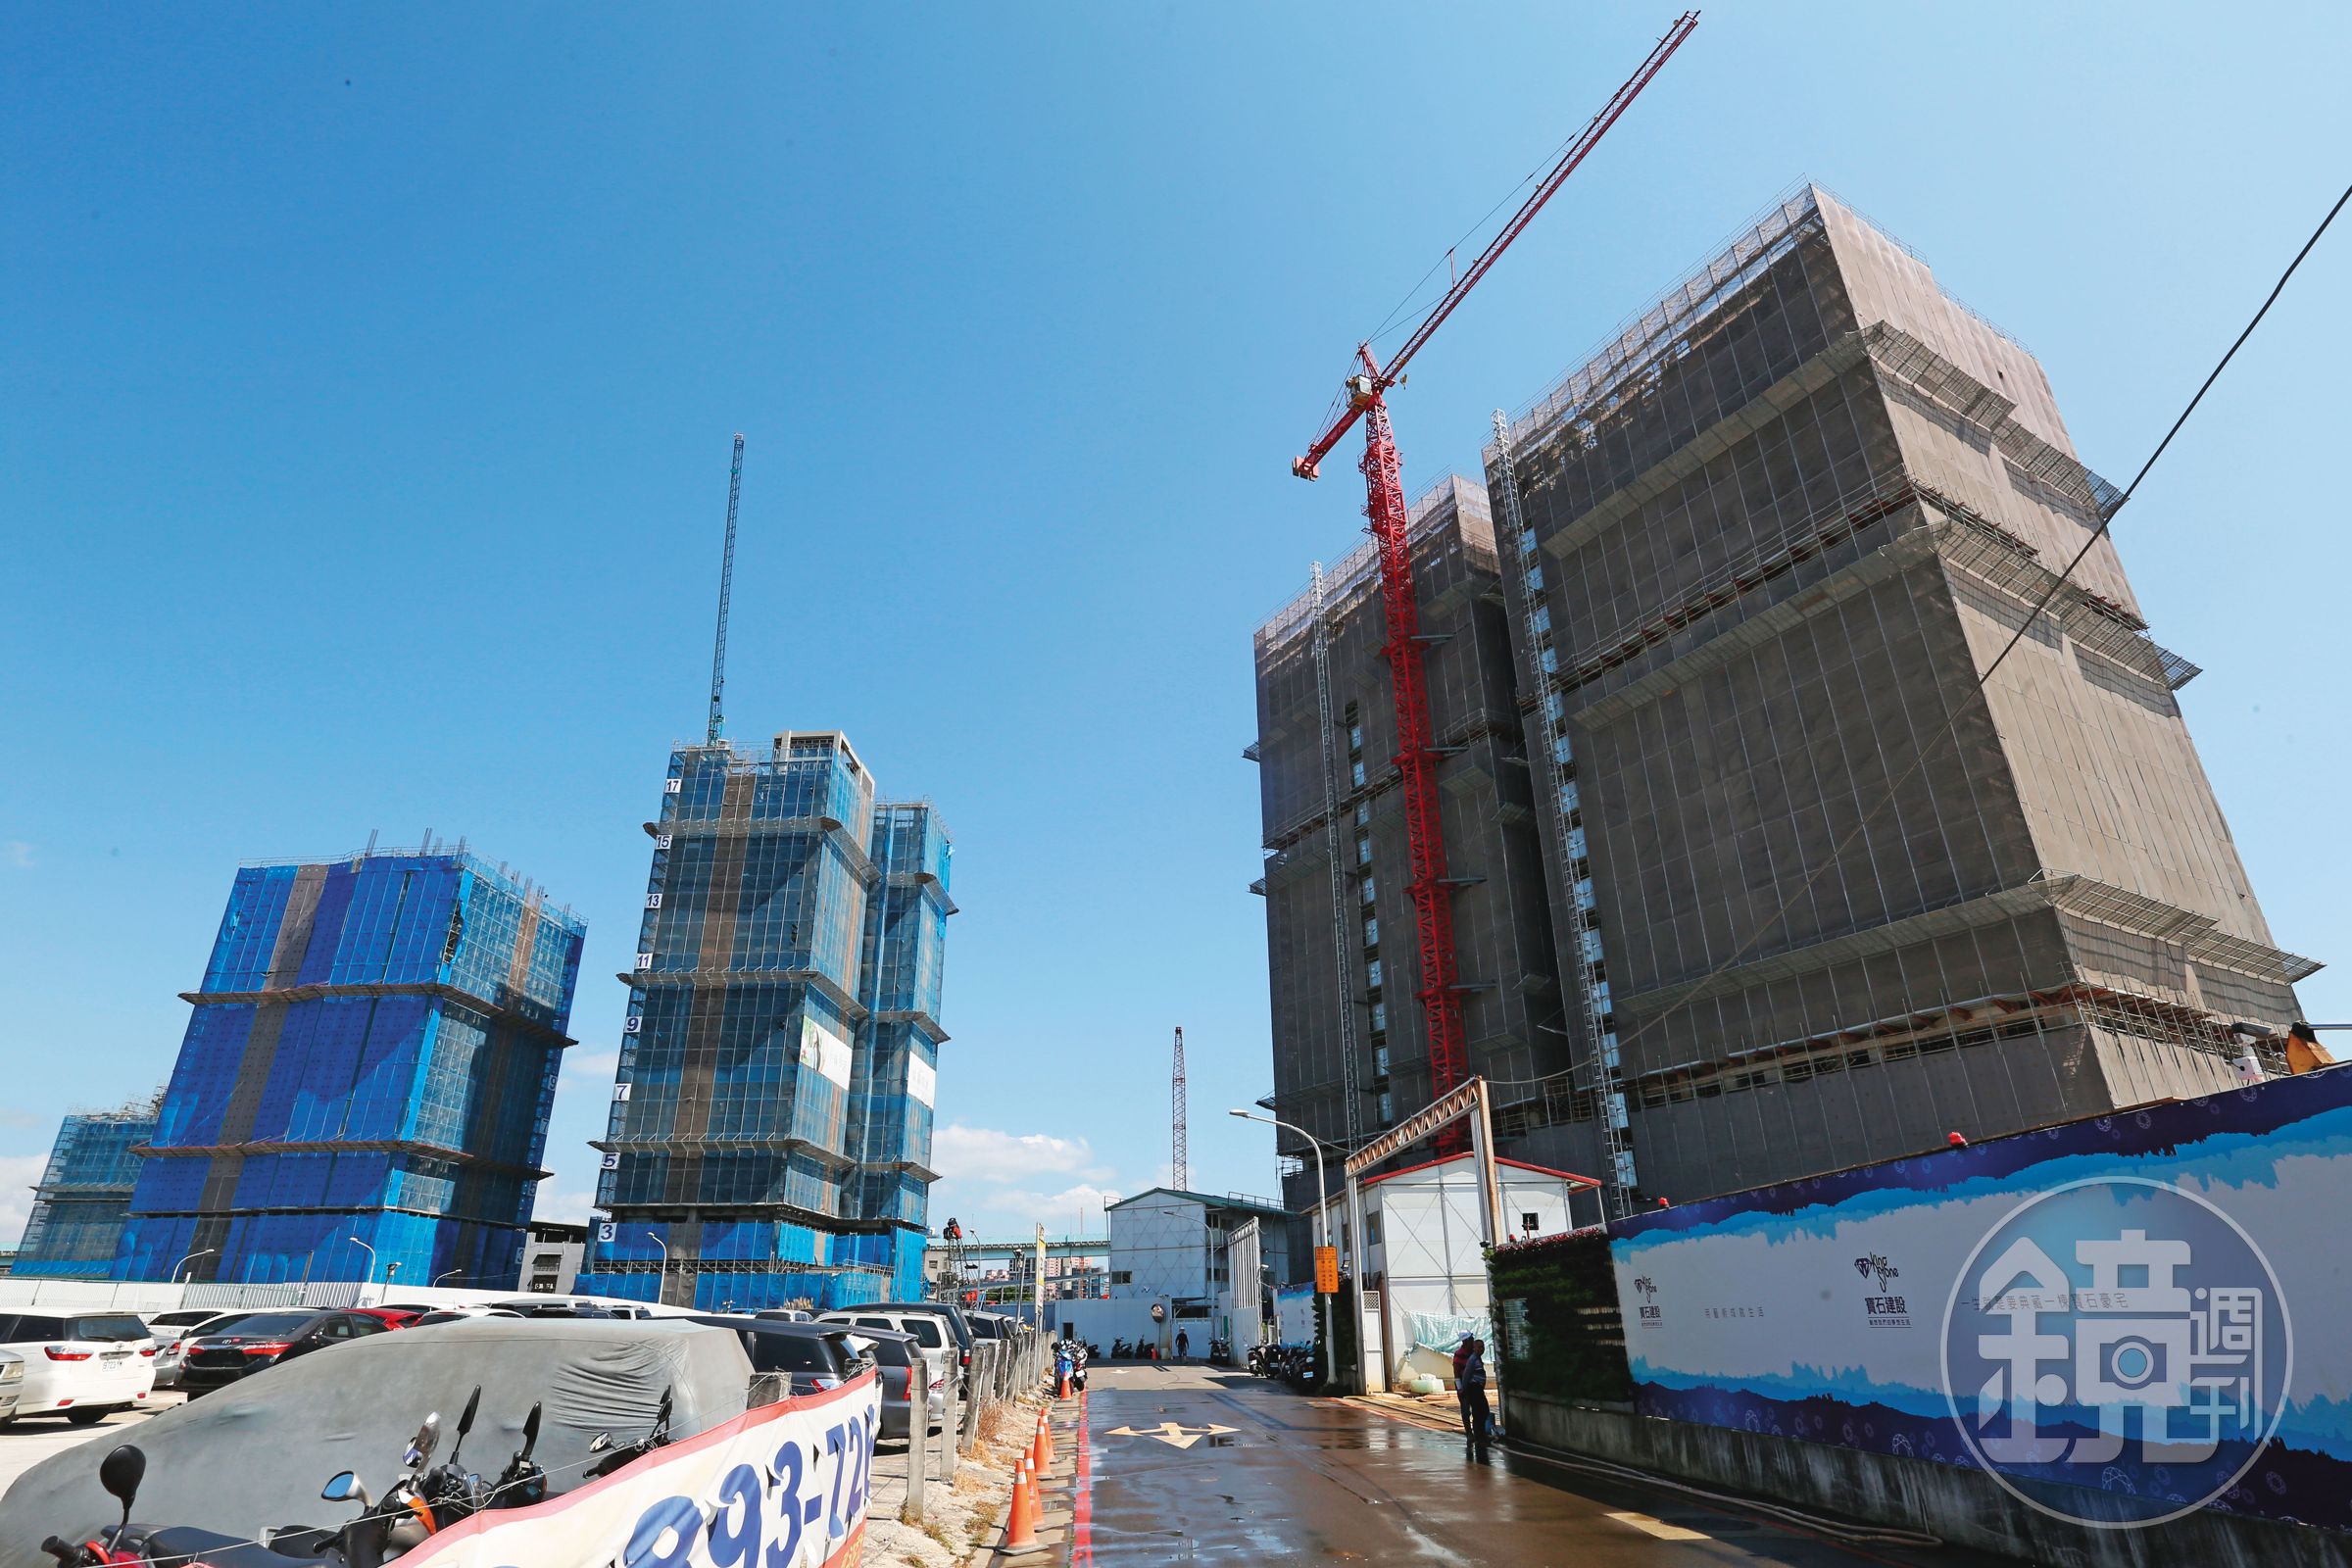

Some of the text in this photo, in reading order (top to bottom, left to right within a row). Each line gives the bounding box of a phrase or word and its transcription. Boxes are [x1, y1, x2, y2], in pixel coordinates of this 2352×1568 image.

[666, 780, 679, 792] 17
[658, 836, 670, 848] 15
[648, 896, 660, 906] 13
[638, 956, 650, 967] 11
[627, 1017, 638, 1032] 9
[616, 1085, 628, 1100] 7
[603, 1153, 616, 1167] 5
[600, 1225, 612, 1240] 3
[1865, 1296, 1907, 1314] 寶石建設
